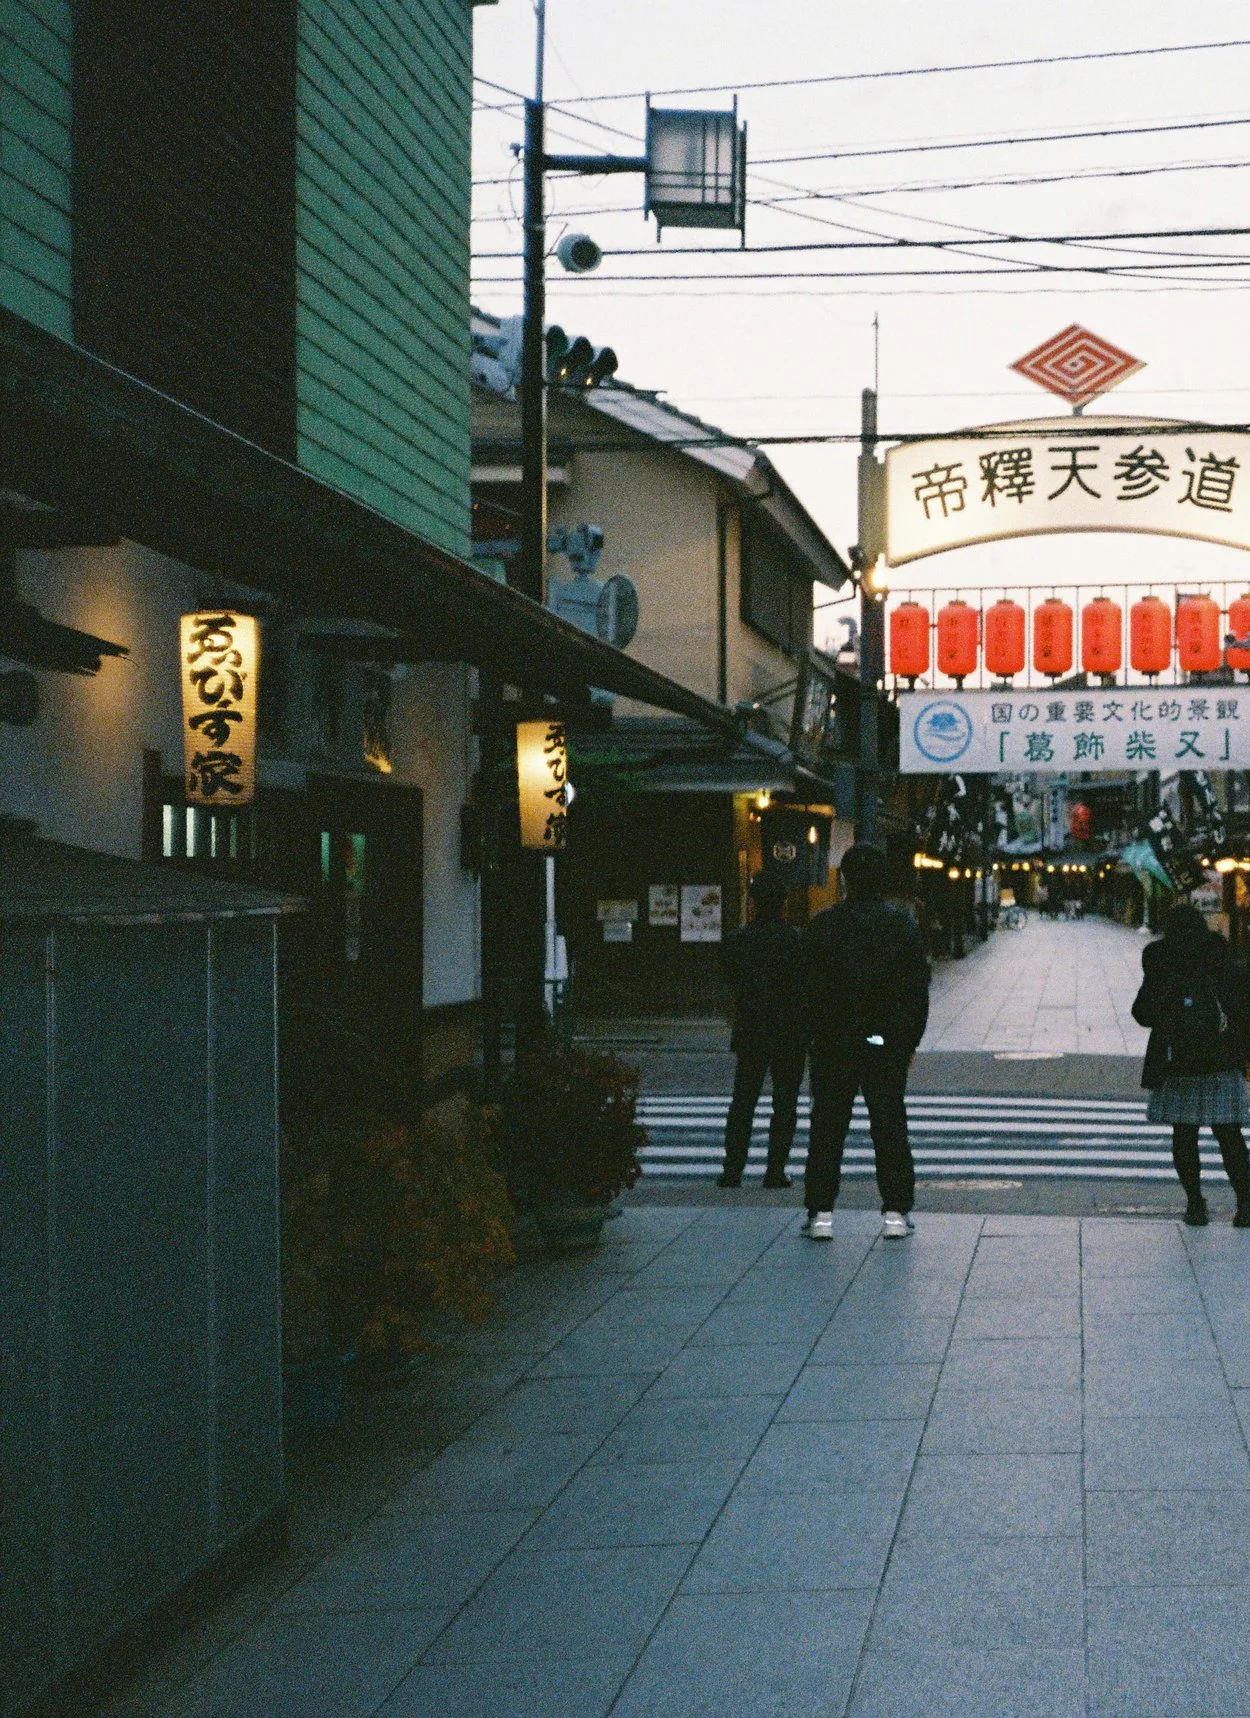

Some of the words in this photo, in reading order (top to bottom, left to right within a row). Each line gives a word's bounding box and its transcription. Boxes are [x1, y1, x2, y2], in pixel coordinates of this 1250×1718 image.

[911, 444, 1241, 520] 帝釋天参道
[991, 699, 1240, 724] 国の重要文化的景観
[1000, 728, 1231, 763] 「葛飾柴又」
